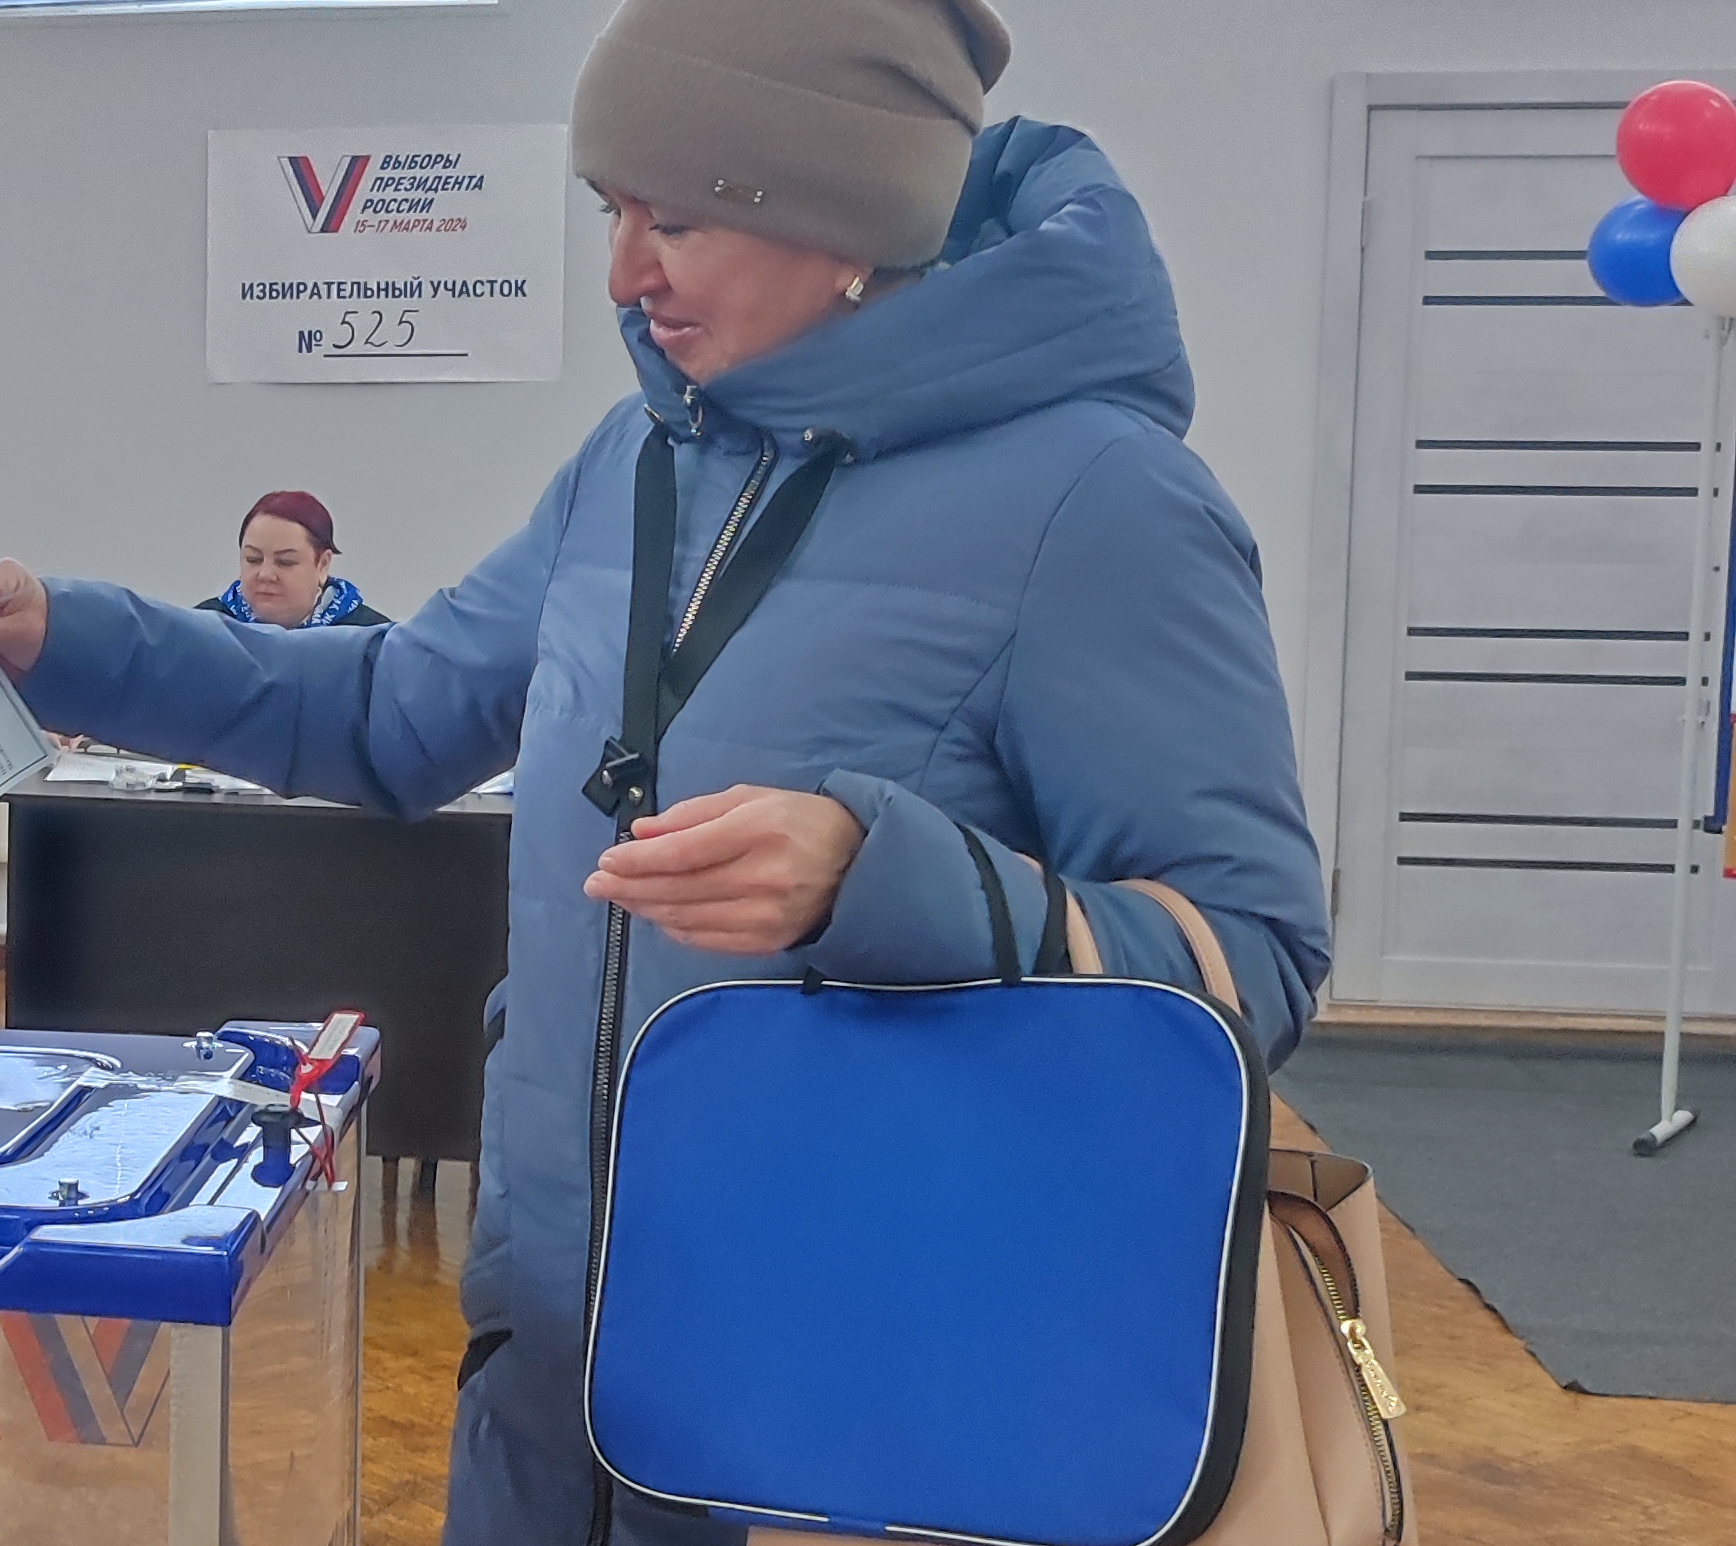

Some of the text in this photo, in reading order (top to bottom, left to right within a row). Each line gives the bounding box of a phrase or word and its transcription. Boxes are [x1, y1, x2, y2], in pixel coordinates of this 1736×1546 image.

[379, 153, 461, 171] ВЫБОРЫ
[369, 174, 485, 194] ПРЕЗИДЕНТА
[360, 197, 435, 215] РОССИИ
[389, 218, 436, 234] МАРТА
[435, 217, 468, 233] 2024
[240, 275, 528, 301] ИЗБИРАТЕЛЬНЫЙ УЧАСТОК
[297, 309, 420, 354] № 525
